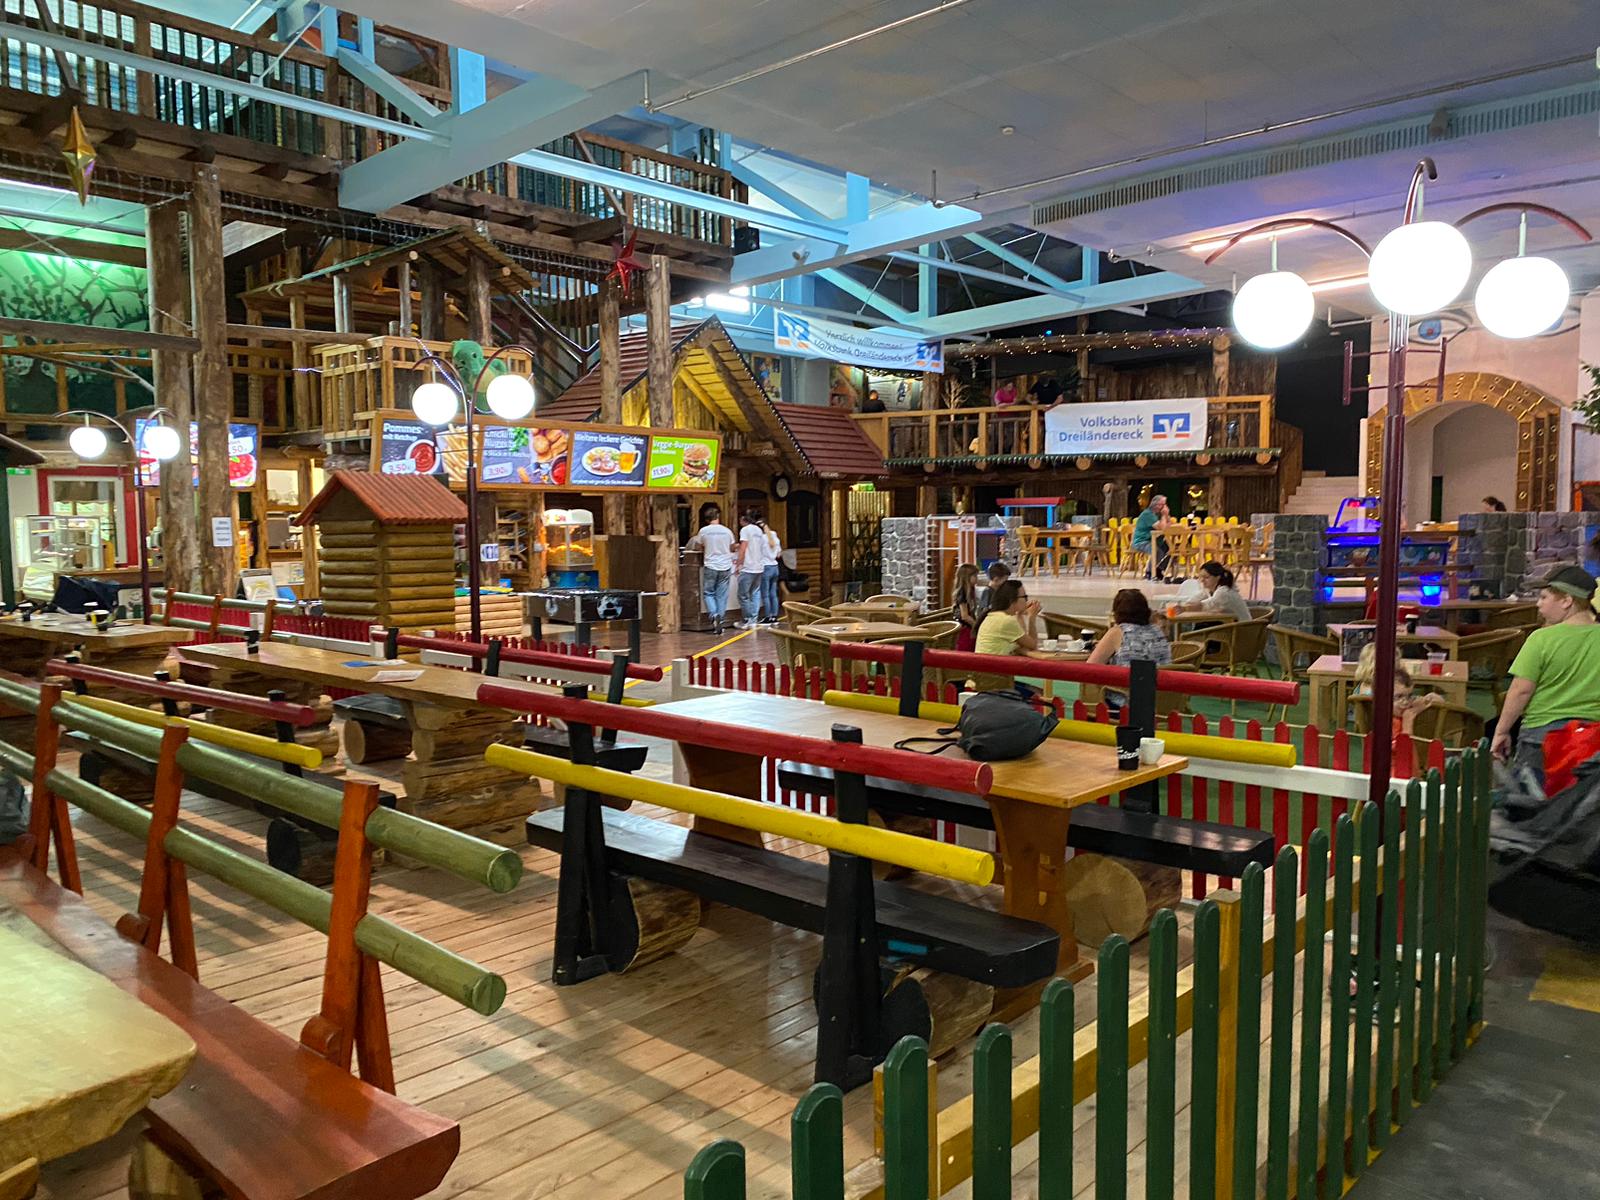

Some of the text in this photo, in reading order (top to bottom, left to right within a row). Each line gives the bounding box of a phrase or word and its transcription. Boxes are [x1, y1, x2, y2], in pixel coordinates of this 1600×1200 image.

[383, 422, 422, 434] Pommes
[1080, 415, 1144, 428] Volksbank
[1059, 429, 1143, 442] Dreiländereck
